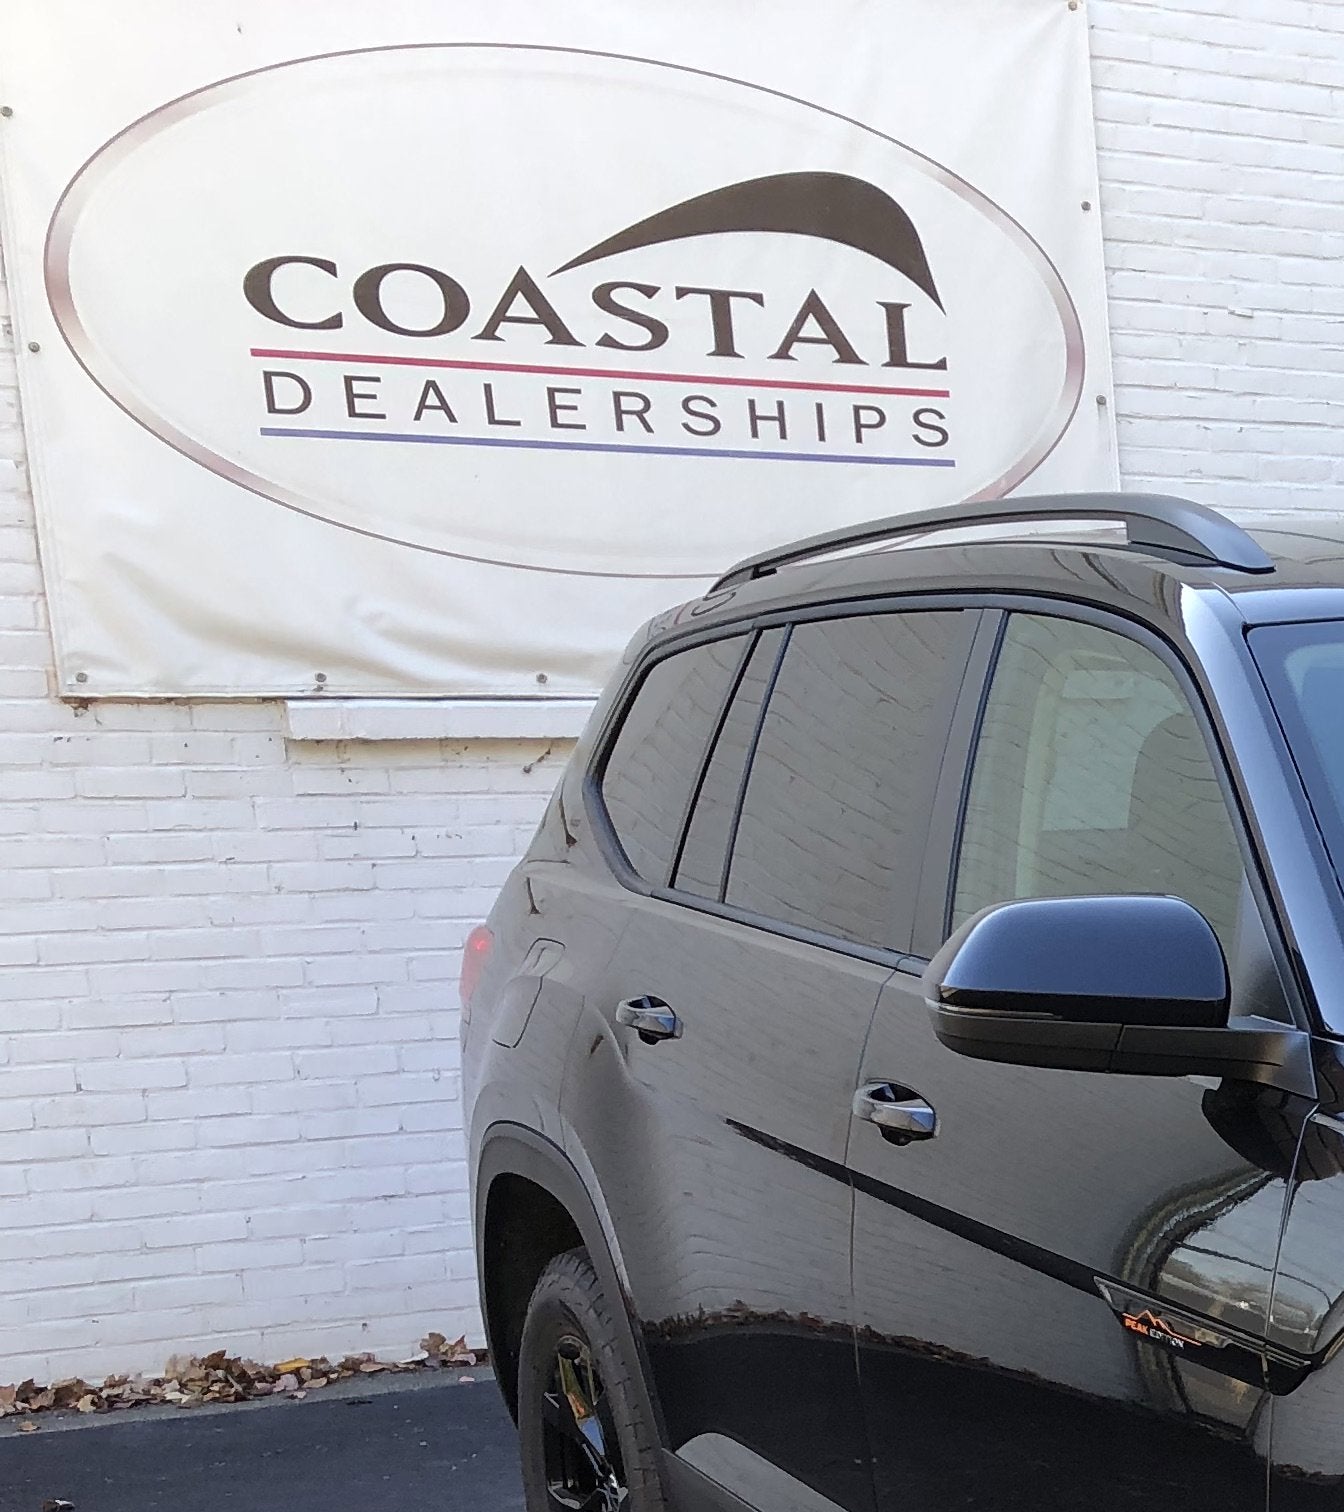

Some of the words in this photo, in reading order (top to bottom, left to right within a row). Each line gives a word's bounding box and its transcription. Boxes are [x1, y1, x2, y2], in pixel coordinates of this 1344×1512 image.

[242, 254, 949, 371] COASTAL
[263, 369, 952, 448] DEALERSHIPS
[1125, 1318, 1149, 1335] PEAK
